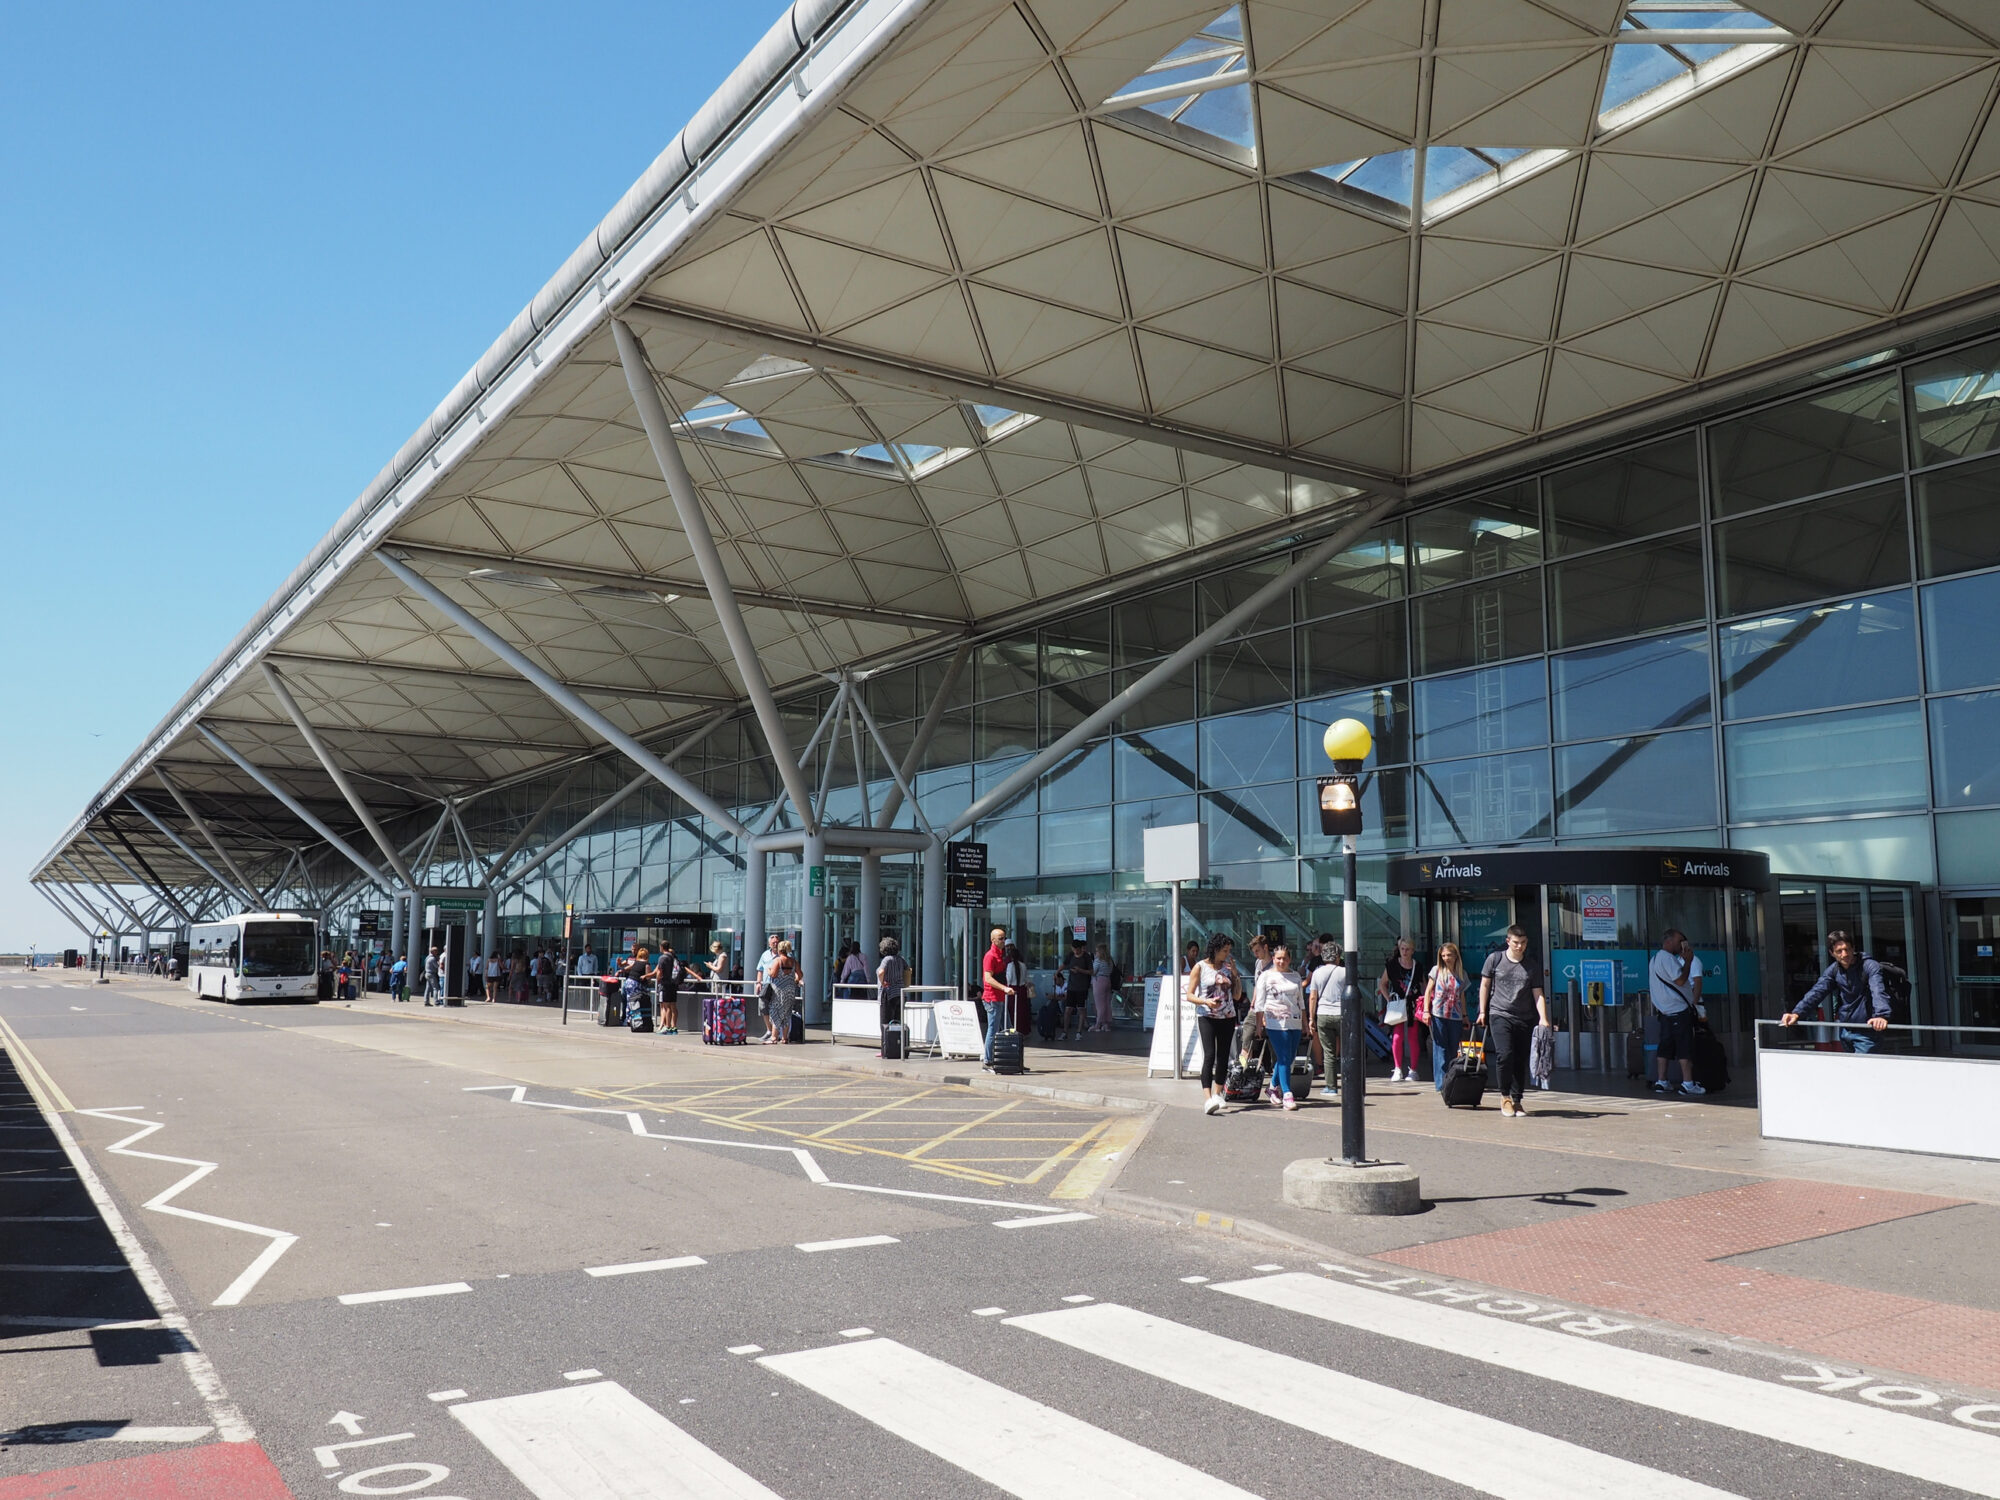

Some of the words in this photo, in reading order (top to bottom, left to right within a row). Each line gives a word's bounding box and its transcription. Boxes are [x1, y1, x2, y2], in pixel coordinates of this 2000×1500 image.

[1435, 863, 1482, 879] Arrivals
[1684, 861, 1730, 877] Arrivals
[1467, 906, 1487, 918] place
[1487, 906, 1497, 916] by
[654, 917, 691, 925] Departures
[1461, 918, 1473, 926] the
[1474, 917, 1492, 927] sea?
[1355, 1277, 1635, 1337] RIGHT
[312, 1432, 451, 1500] LO
